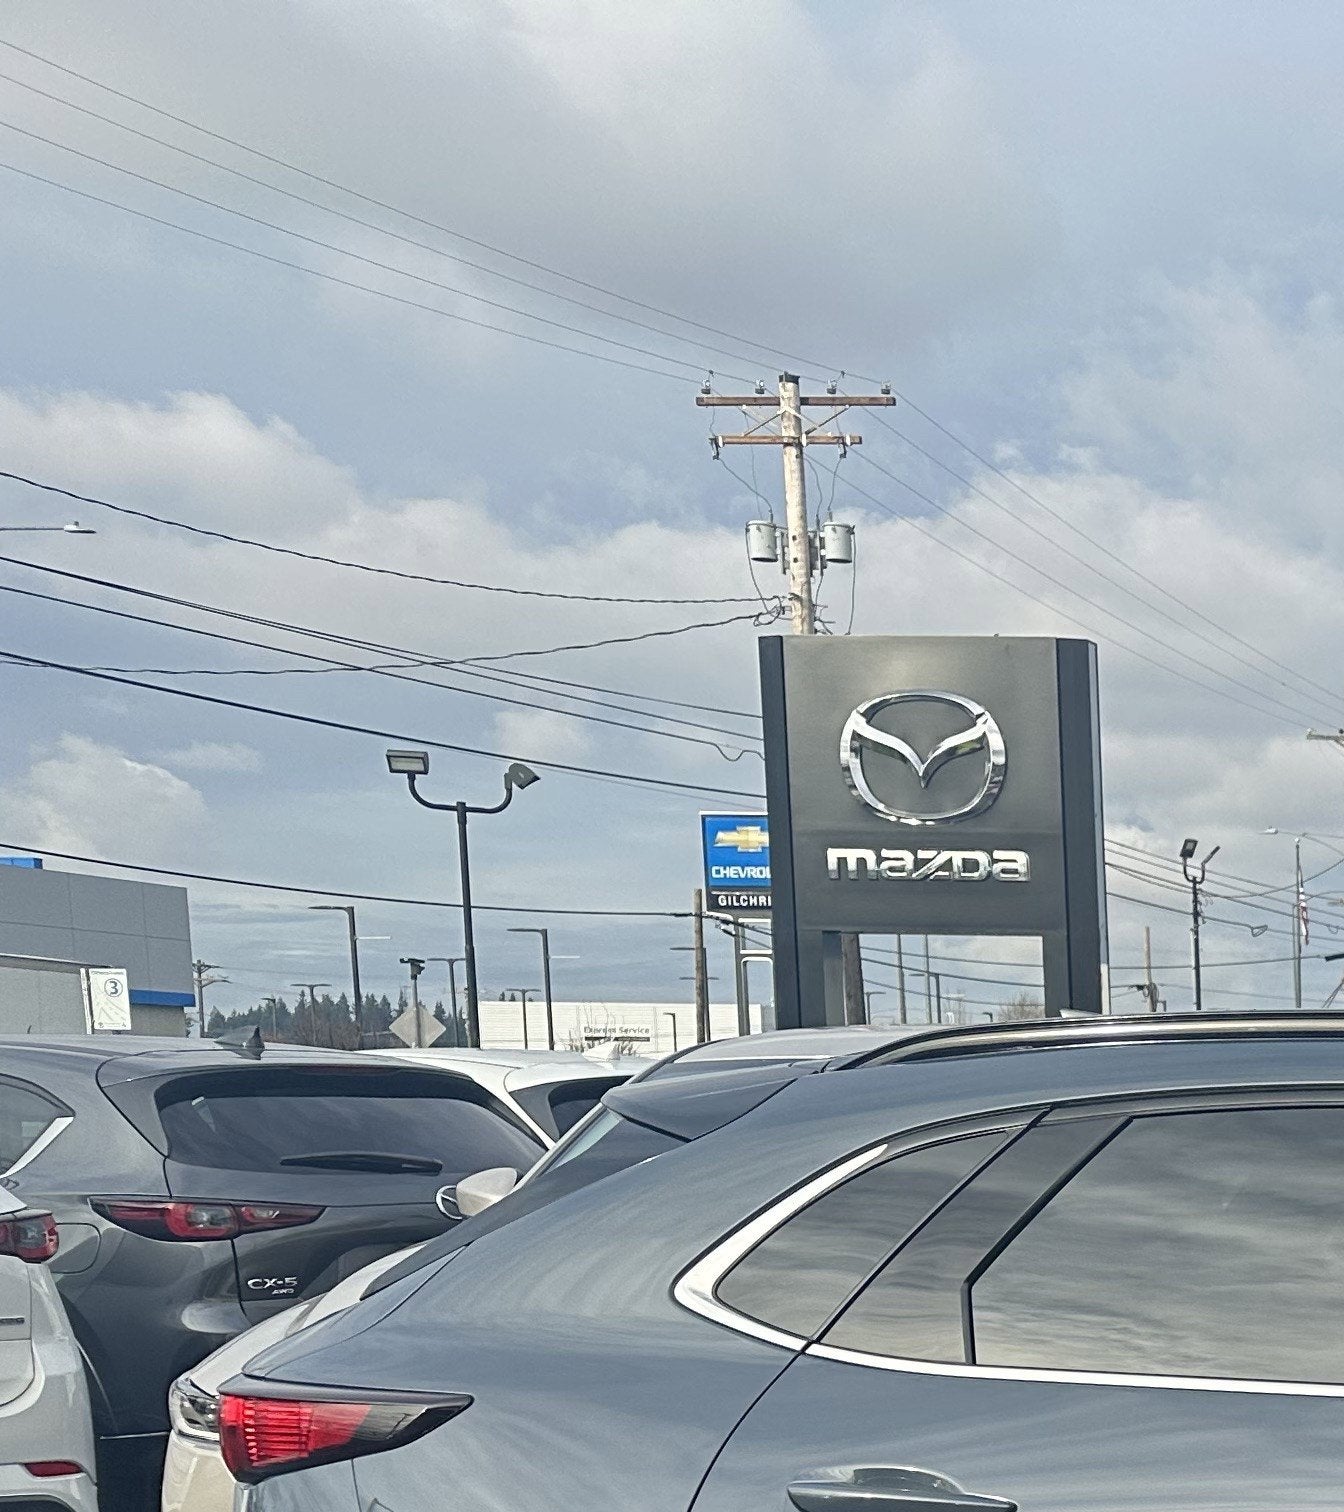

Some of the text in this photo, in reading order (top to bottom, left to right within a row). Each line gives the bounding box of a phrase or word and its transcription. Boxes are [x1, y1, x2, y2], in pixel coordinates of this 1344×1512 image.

[711, 865, 772, 879] CHEVROL
[717, 895, 772, 907] GILCHRI
[109, 980, 119, 995] 3
[247, 1277, 298, 1290] CX-5
